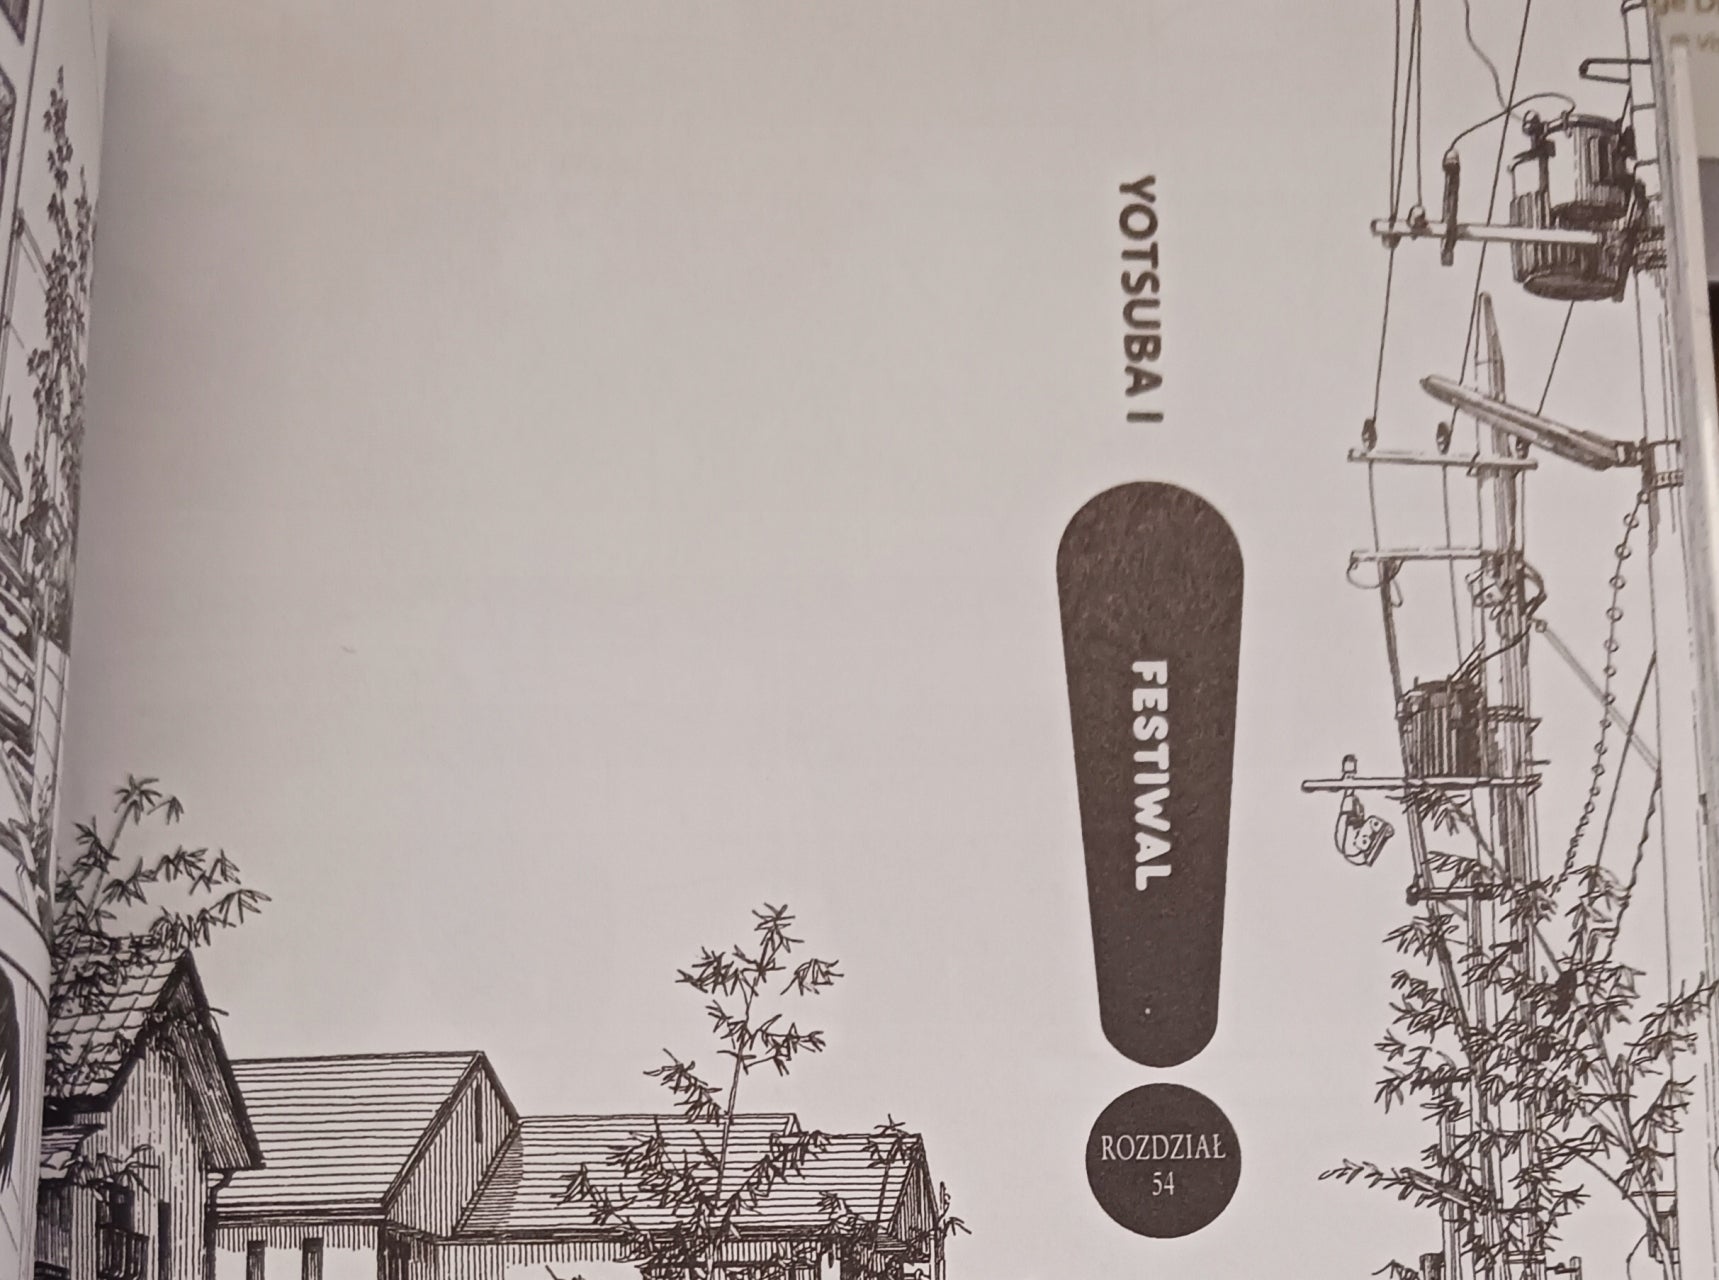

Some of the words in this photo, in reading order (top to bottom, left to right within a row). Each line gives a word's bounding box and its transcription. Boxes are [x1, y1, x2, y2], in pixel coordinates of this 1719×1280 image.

[1118, 174, 1163, 397] YOTSUBA
[1126, 411, 1164, 424] I
[1131, 660, 1172, 891] FESTIWAL
[1101, 1133, 1226, 1161] ROZDZIAŁ
[1152, 1171, 1175, 1196] 54
